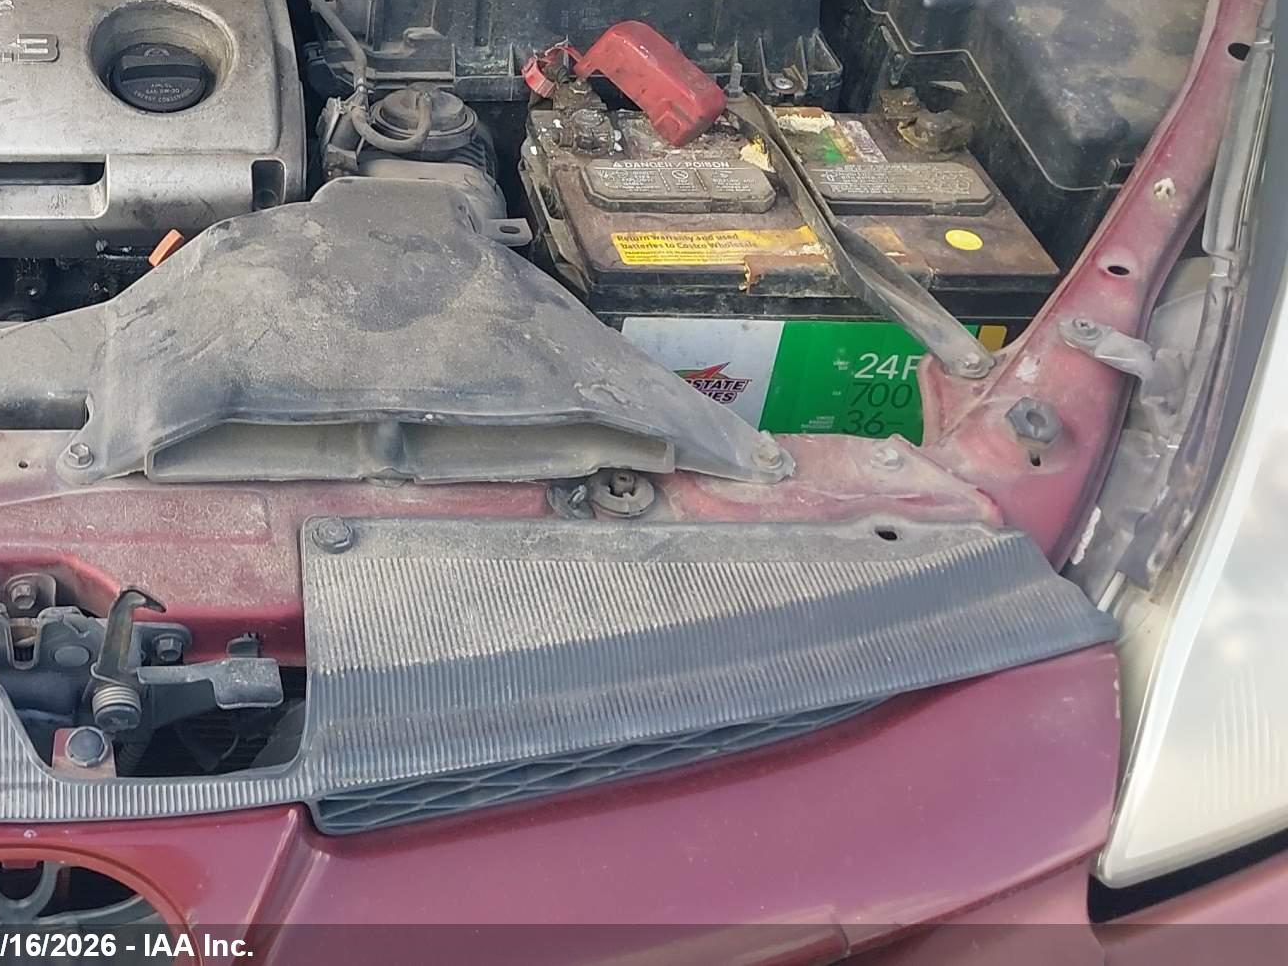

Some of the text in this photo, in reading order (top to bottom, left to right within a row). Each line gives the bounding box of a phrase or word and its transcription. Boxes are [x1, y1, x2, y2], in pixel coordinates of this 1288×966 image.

[623, 161, 673, 169] DANGER
[684, 161, 730, 169] POISON
[617, 234, 650, 242] Return
[696, 234, 714, 242] and
[716, 233, 738, 241] used
[850, 381, 914, 409] 700
